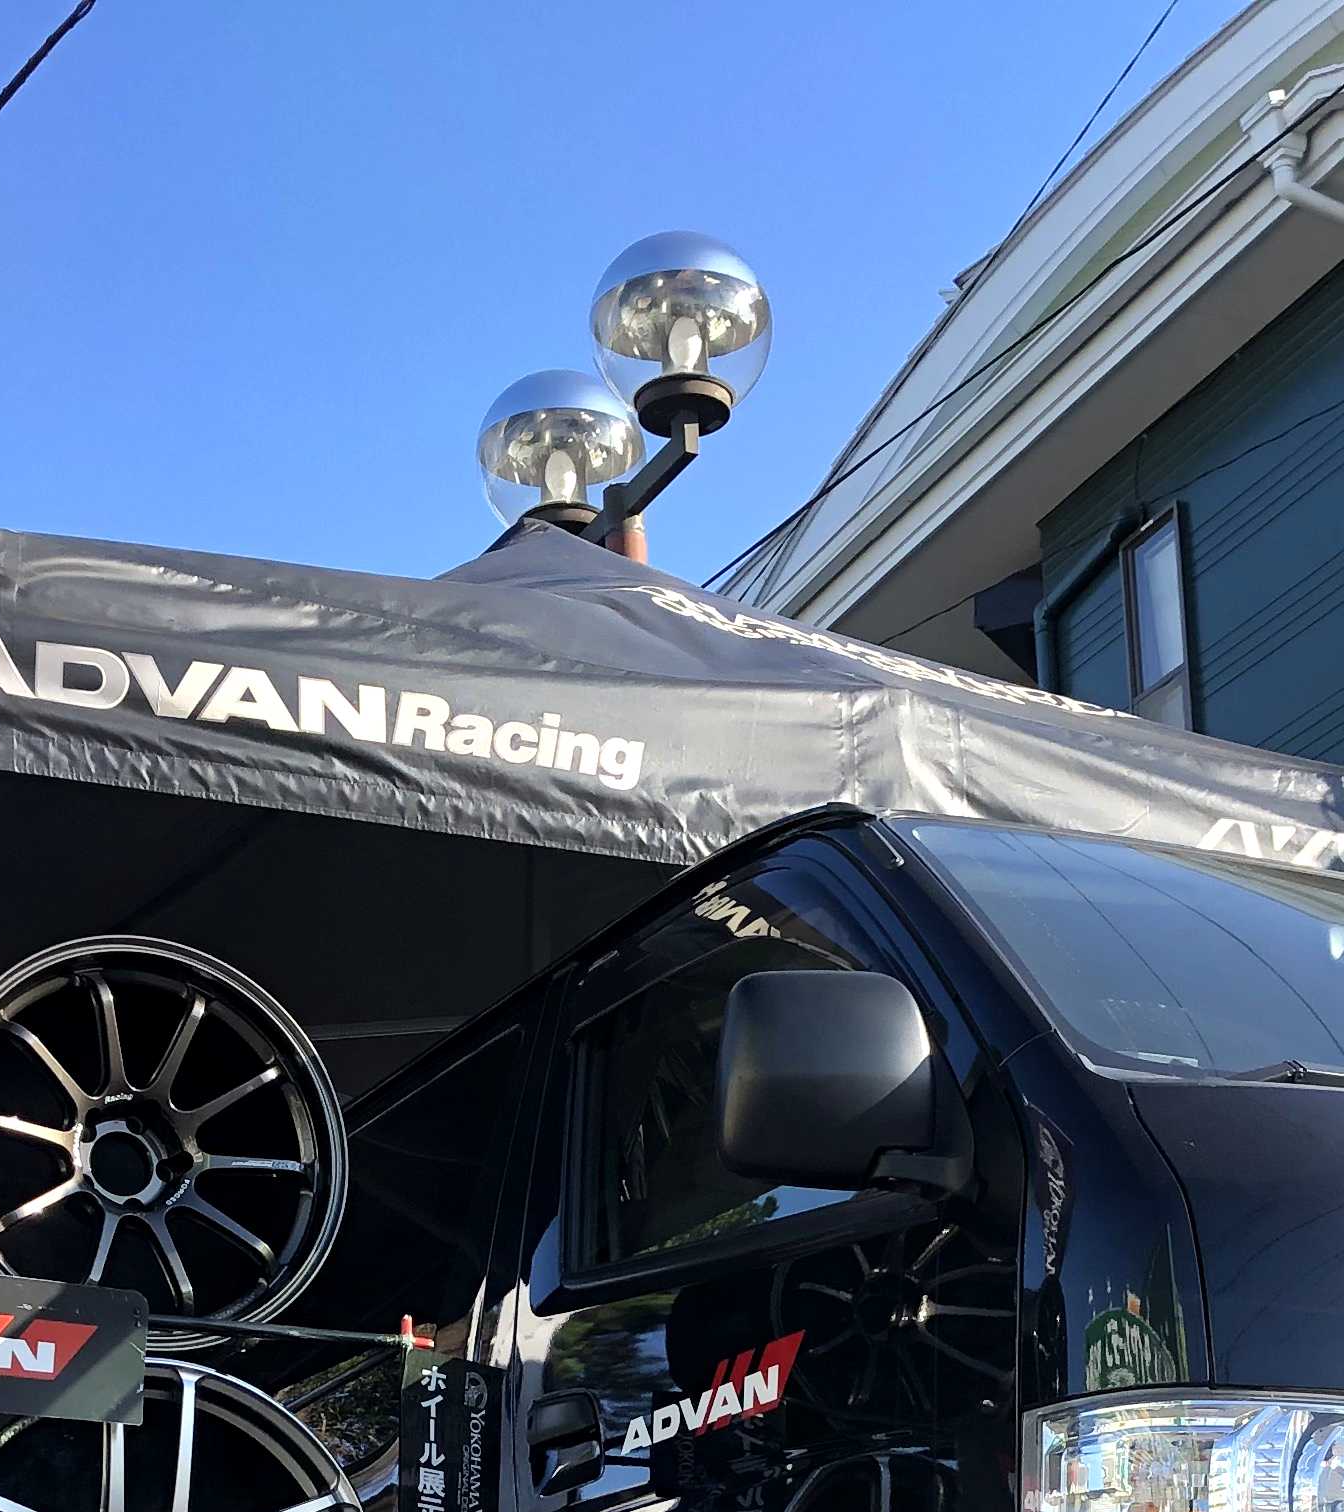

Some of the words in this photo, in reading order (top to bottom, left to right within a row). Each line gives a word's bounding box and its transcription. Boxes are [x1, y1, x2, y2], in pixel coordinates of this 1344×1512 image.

[392, 690, 645, 790] Racing
[468, 1408, 487, 1508] YOKOHAMA
[620, 1364, 780, 1456] ADVAN
